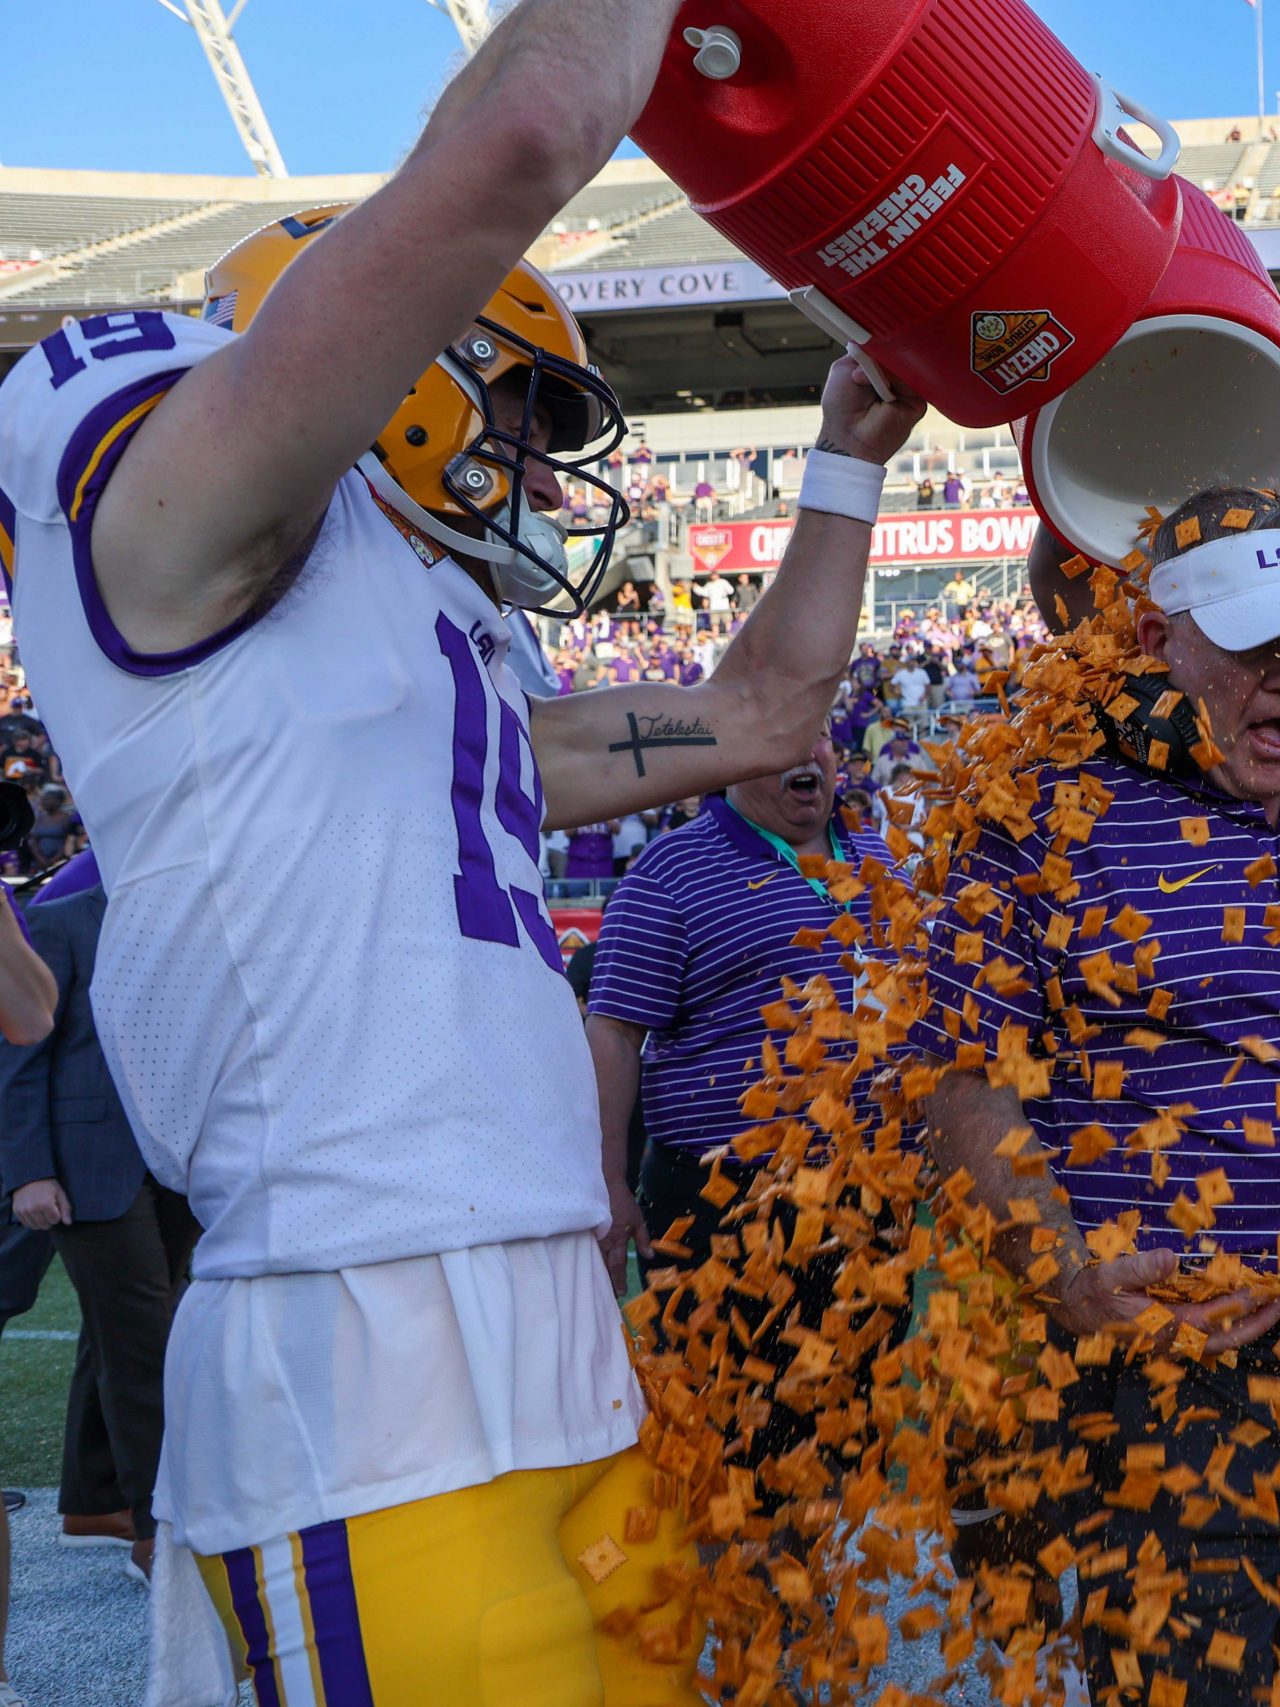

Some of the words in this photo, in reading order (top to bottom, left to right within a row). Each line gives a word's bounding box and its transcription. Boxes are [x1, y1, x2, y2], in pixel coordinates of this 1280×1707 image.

[816, 174, 926, 268] CHEEZIEST
[887, 163, 966, 249] FEELIN'
[838, 241, 889, 278] THE
[557, 277, 646, 301] OVERY
[659, 271, 738, 296] COVE
[1004, 319, 1037, 348] CITRUS
[979, 344, 1006, 364] BOWL
[868, 524, 953, 558] ITRUS
[638, 713, 714, 739] Tetelestai
